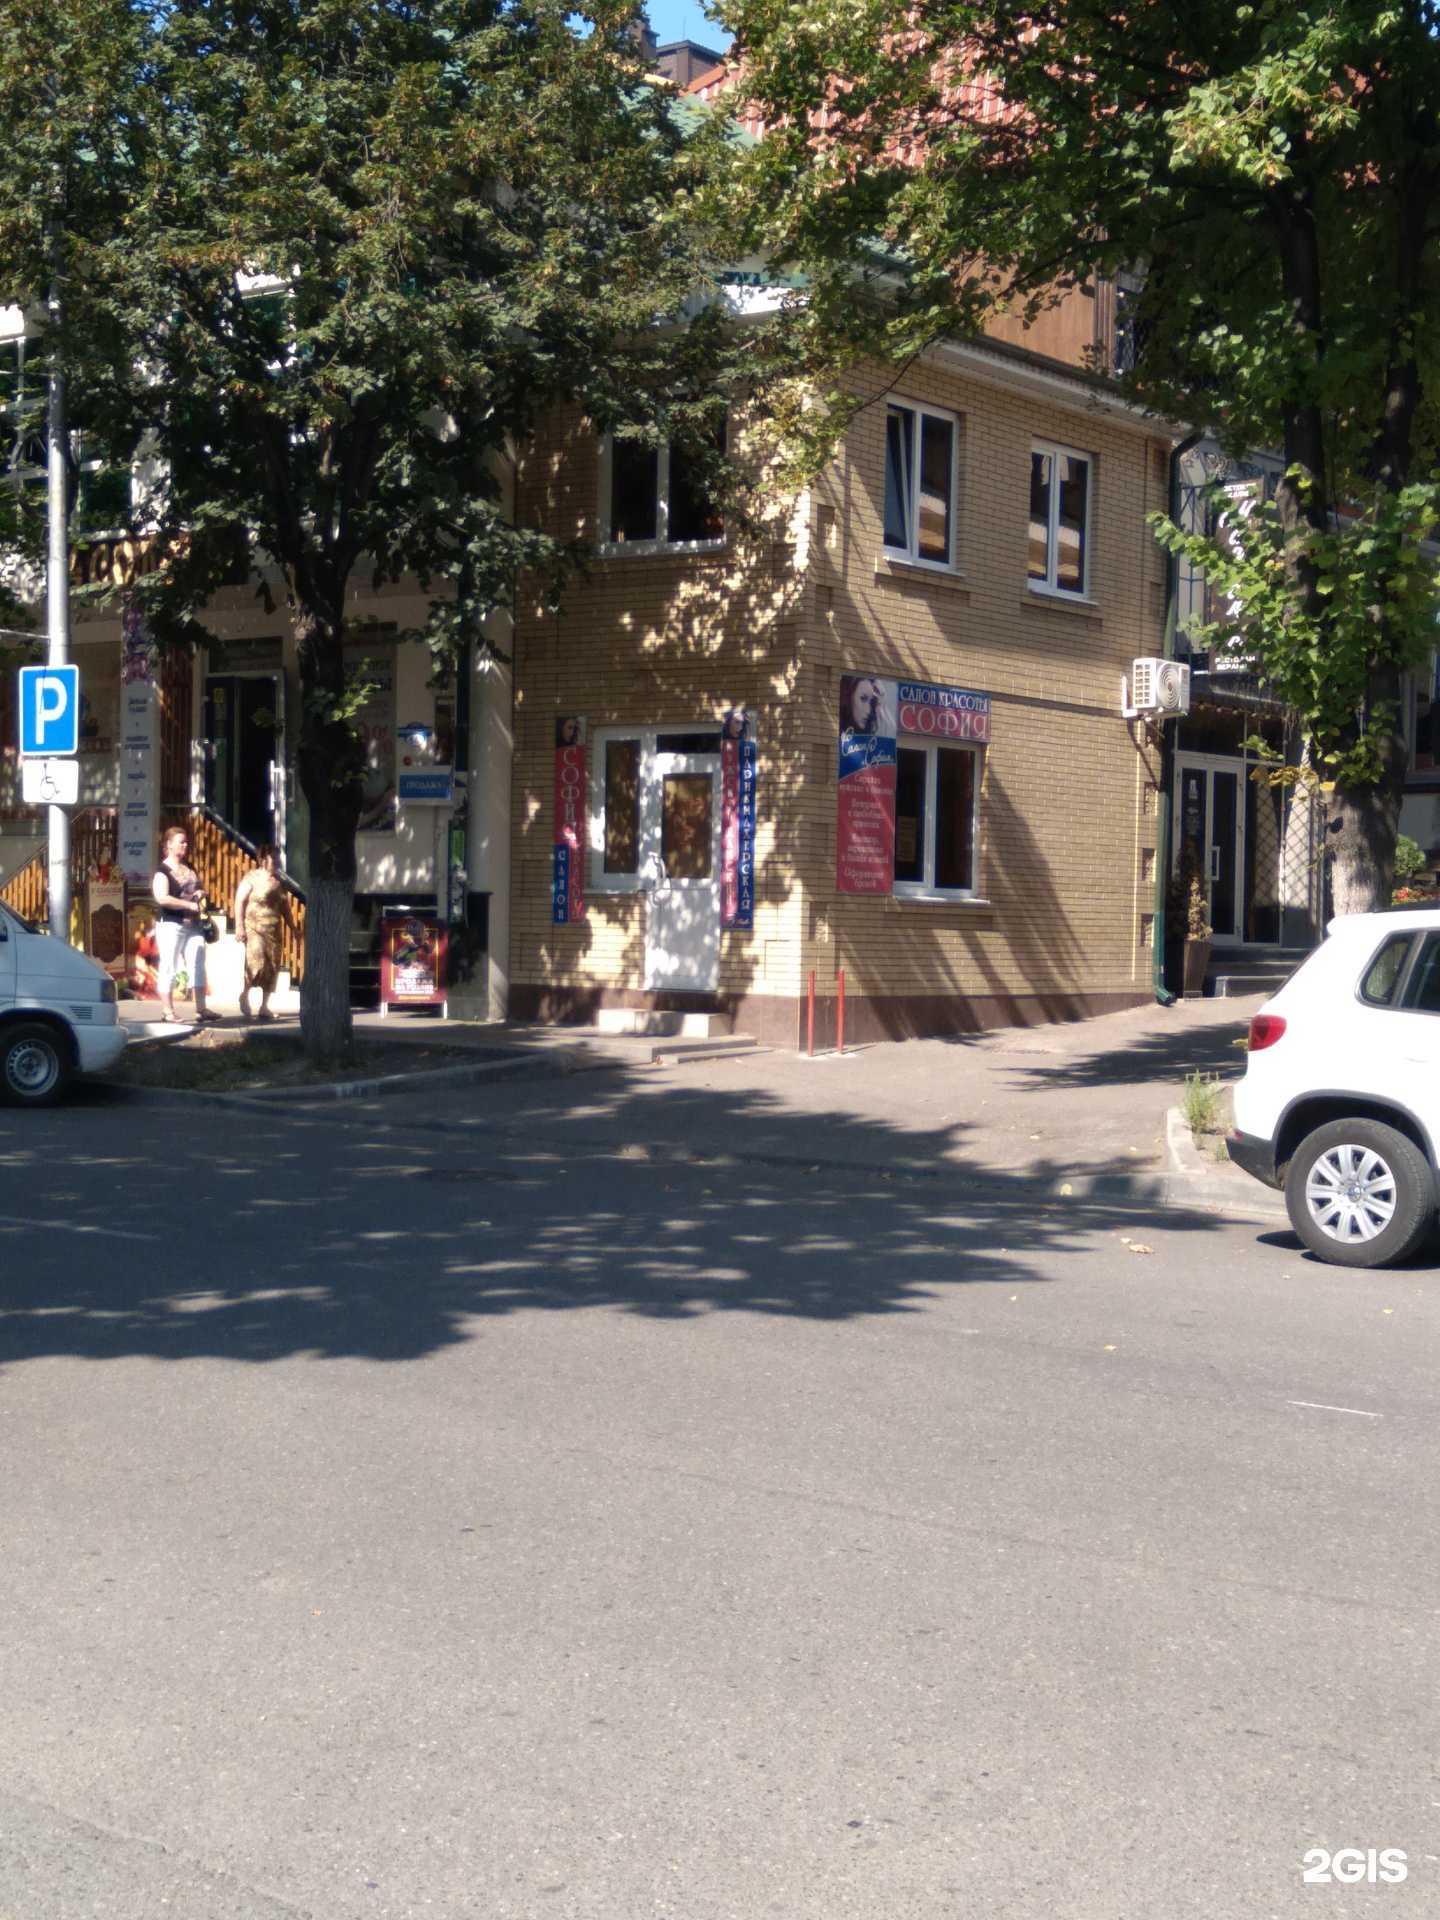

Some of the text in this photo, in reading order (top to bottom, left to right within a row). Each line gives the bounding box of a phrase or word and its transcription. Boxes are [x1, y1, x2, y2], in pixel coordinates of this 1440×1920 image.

[35, 677, 67, 744] P
[900, 686, 988, 713] САЛОН КРАСОТЫ
[900, 704, 988, 739] СОФИЯ
